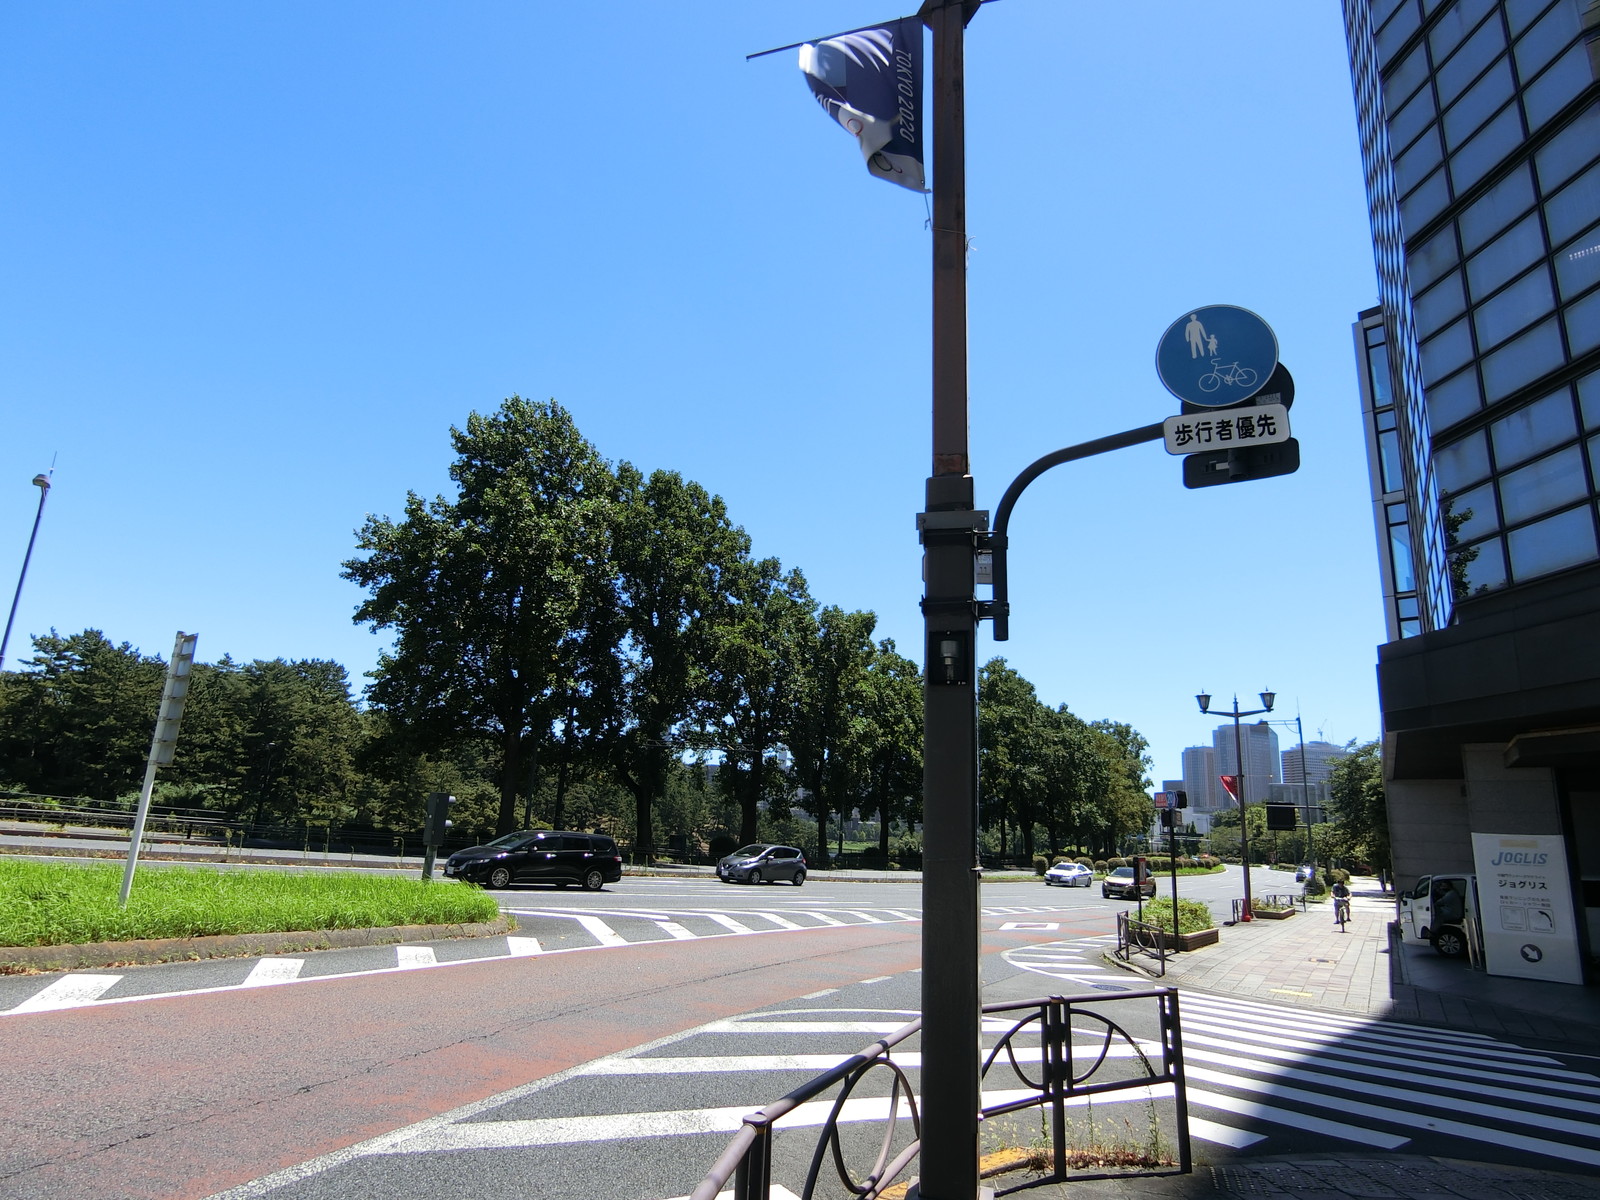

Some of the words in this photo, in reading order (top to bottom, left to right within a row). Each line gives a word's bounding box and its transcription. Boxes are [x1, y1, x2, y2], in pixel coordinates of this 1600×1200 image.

[895, 49, 914, 98] TOKYO
[897, 95, 915, 144] 2020
[1174, 413, 1277, 446] 歩行者優先
[1491, 851, 1548, 866] JOGLIS
[1498, 879, 1548, 890] ジョグリス
